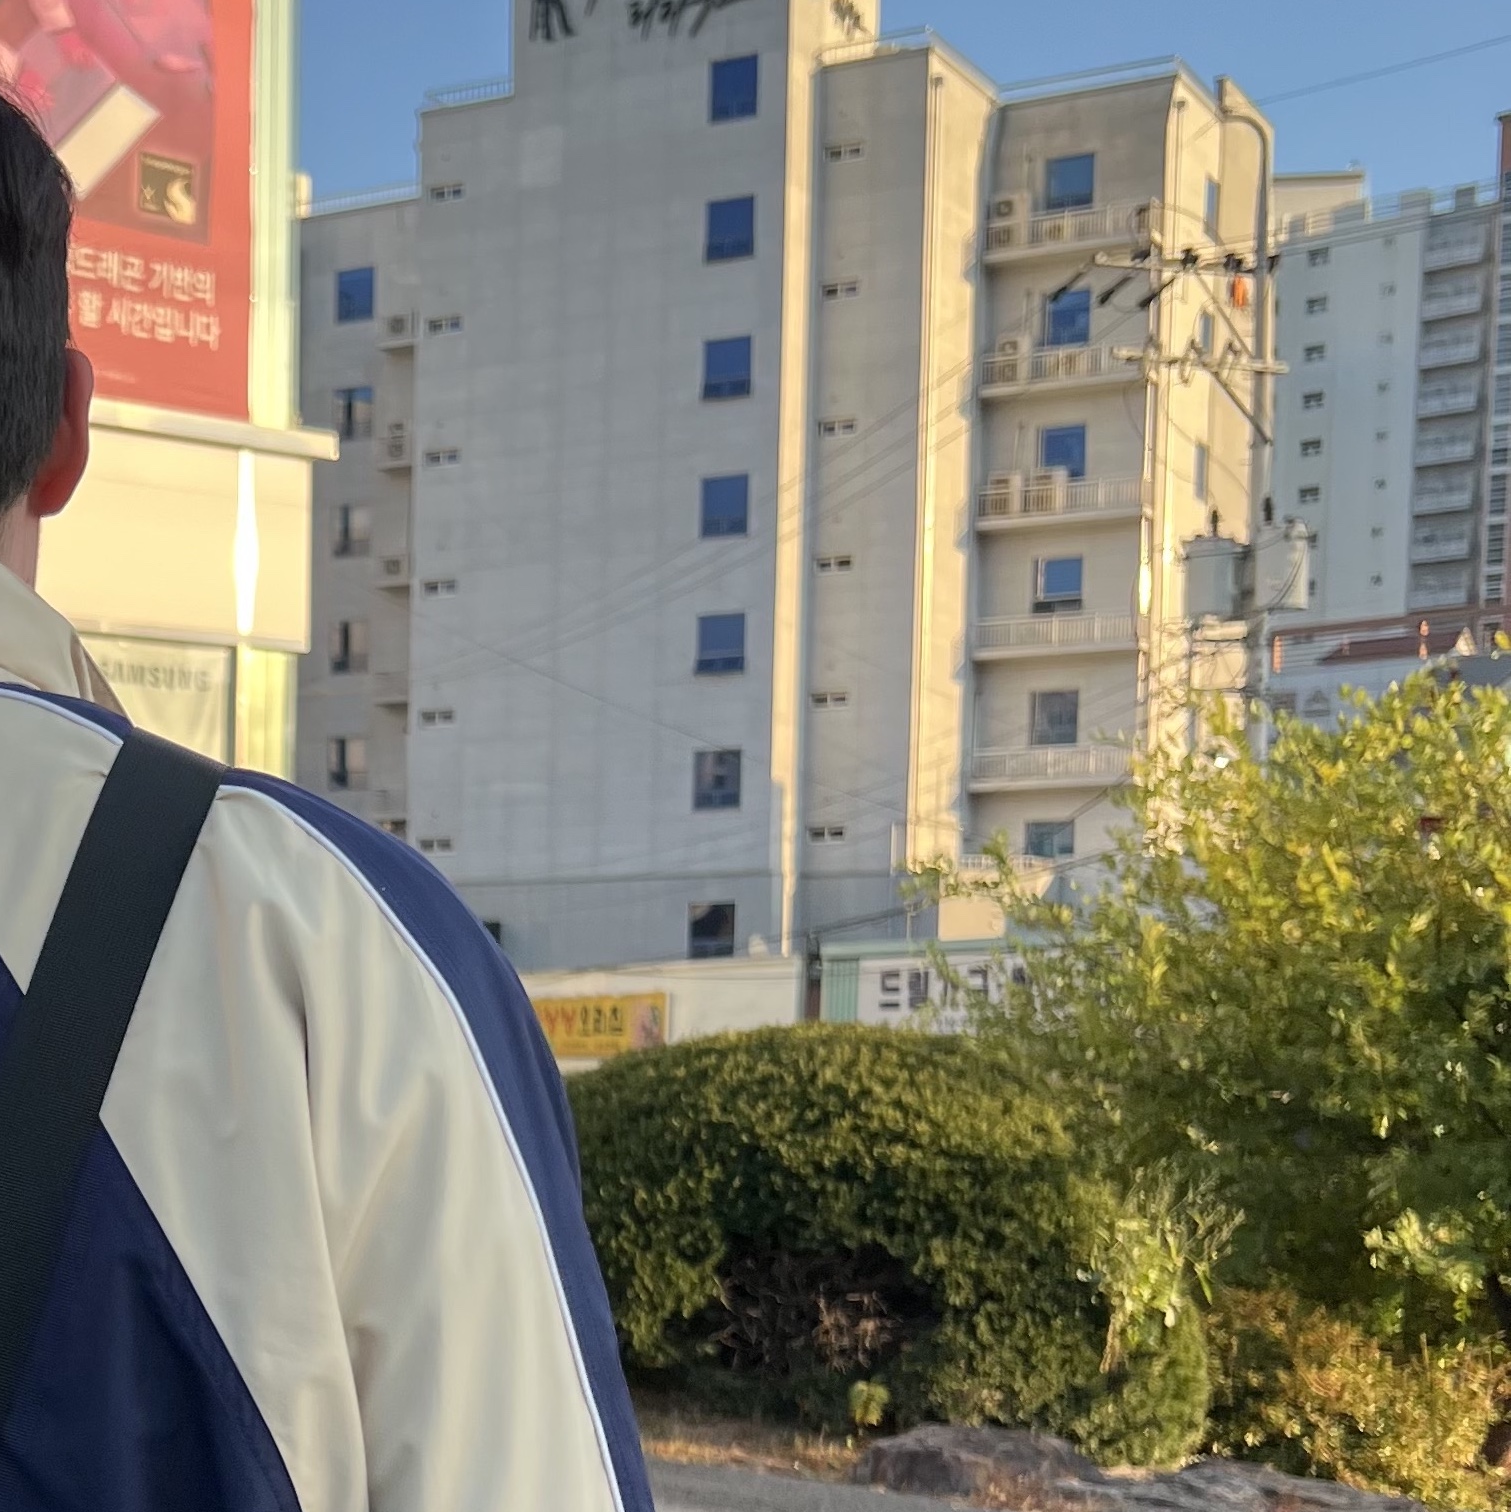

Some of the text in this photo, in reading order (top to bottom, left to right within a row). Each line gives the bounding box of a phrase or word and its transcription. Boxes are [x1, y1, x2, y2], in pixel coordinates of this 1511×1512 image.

[67, 244, 216, 307] 드래곤 기반의
[106, 296, 221, 351] 시간입니다
